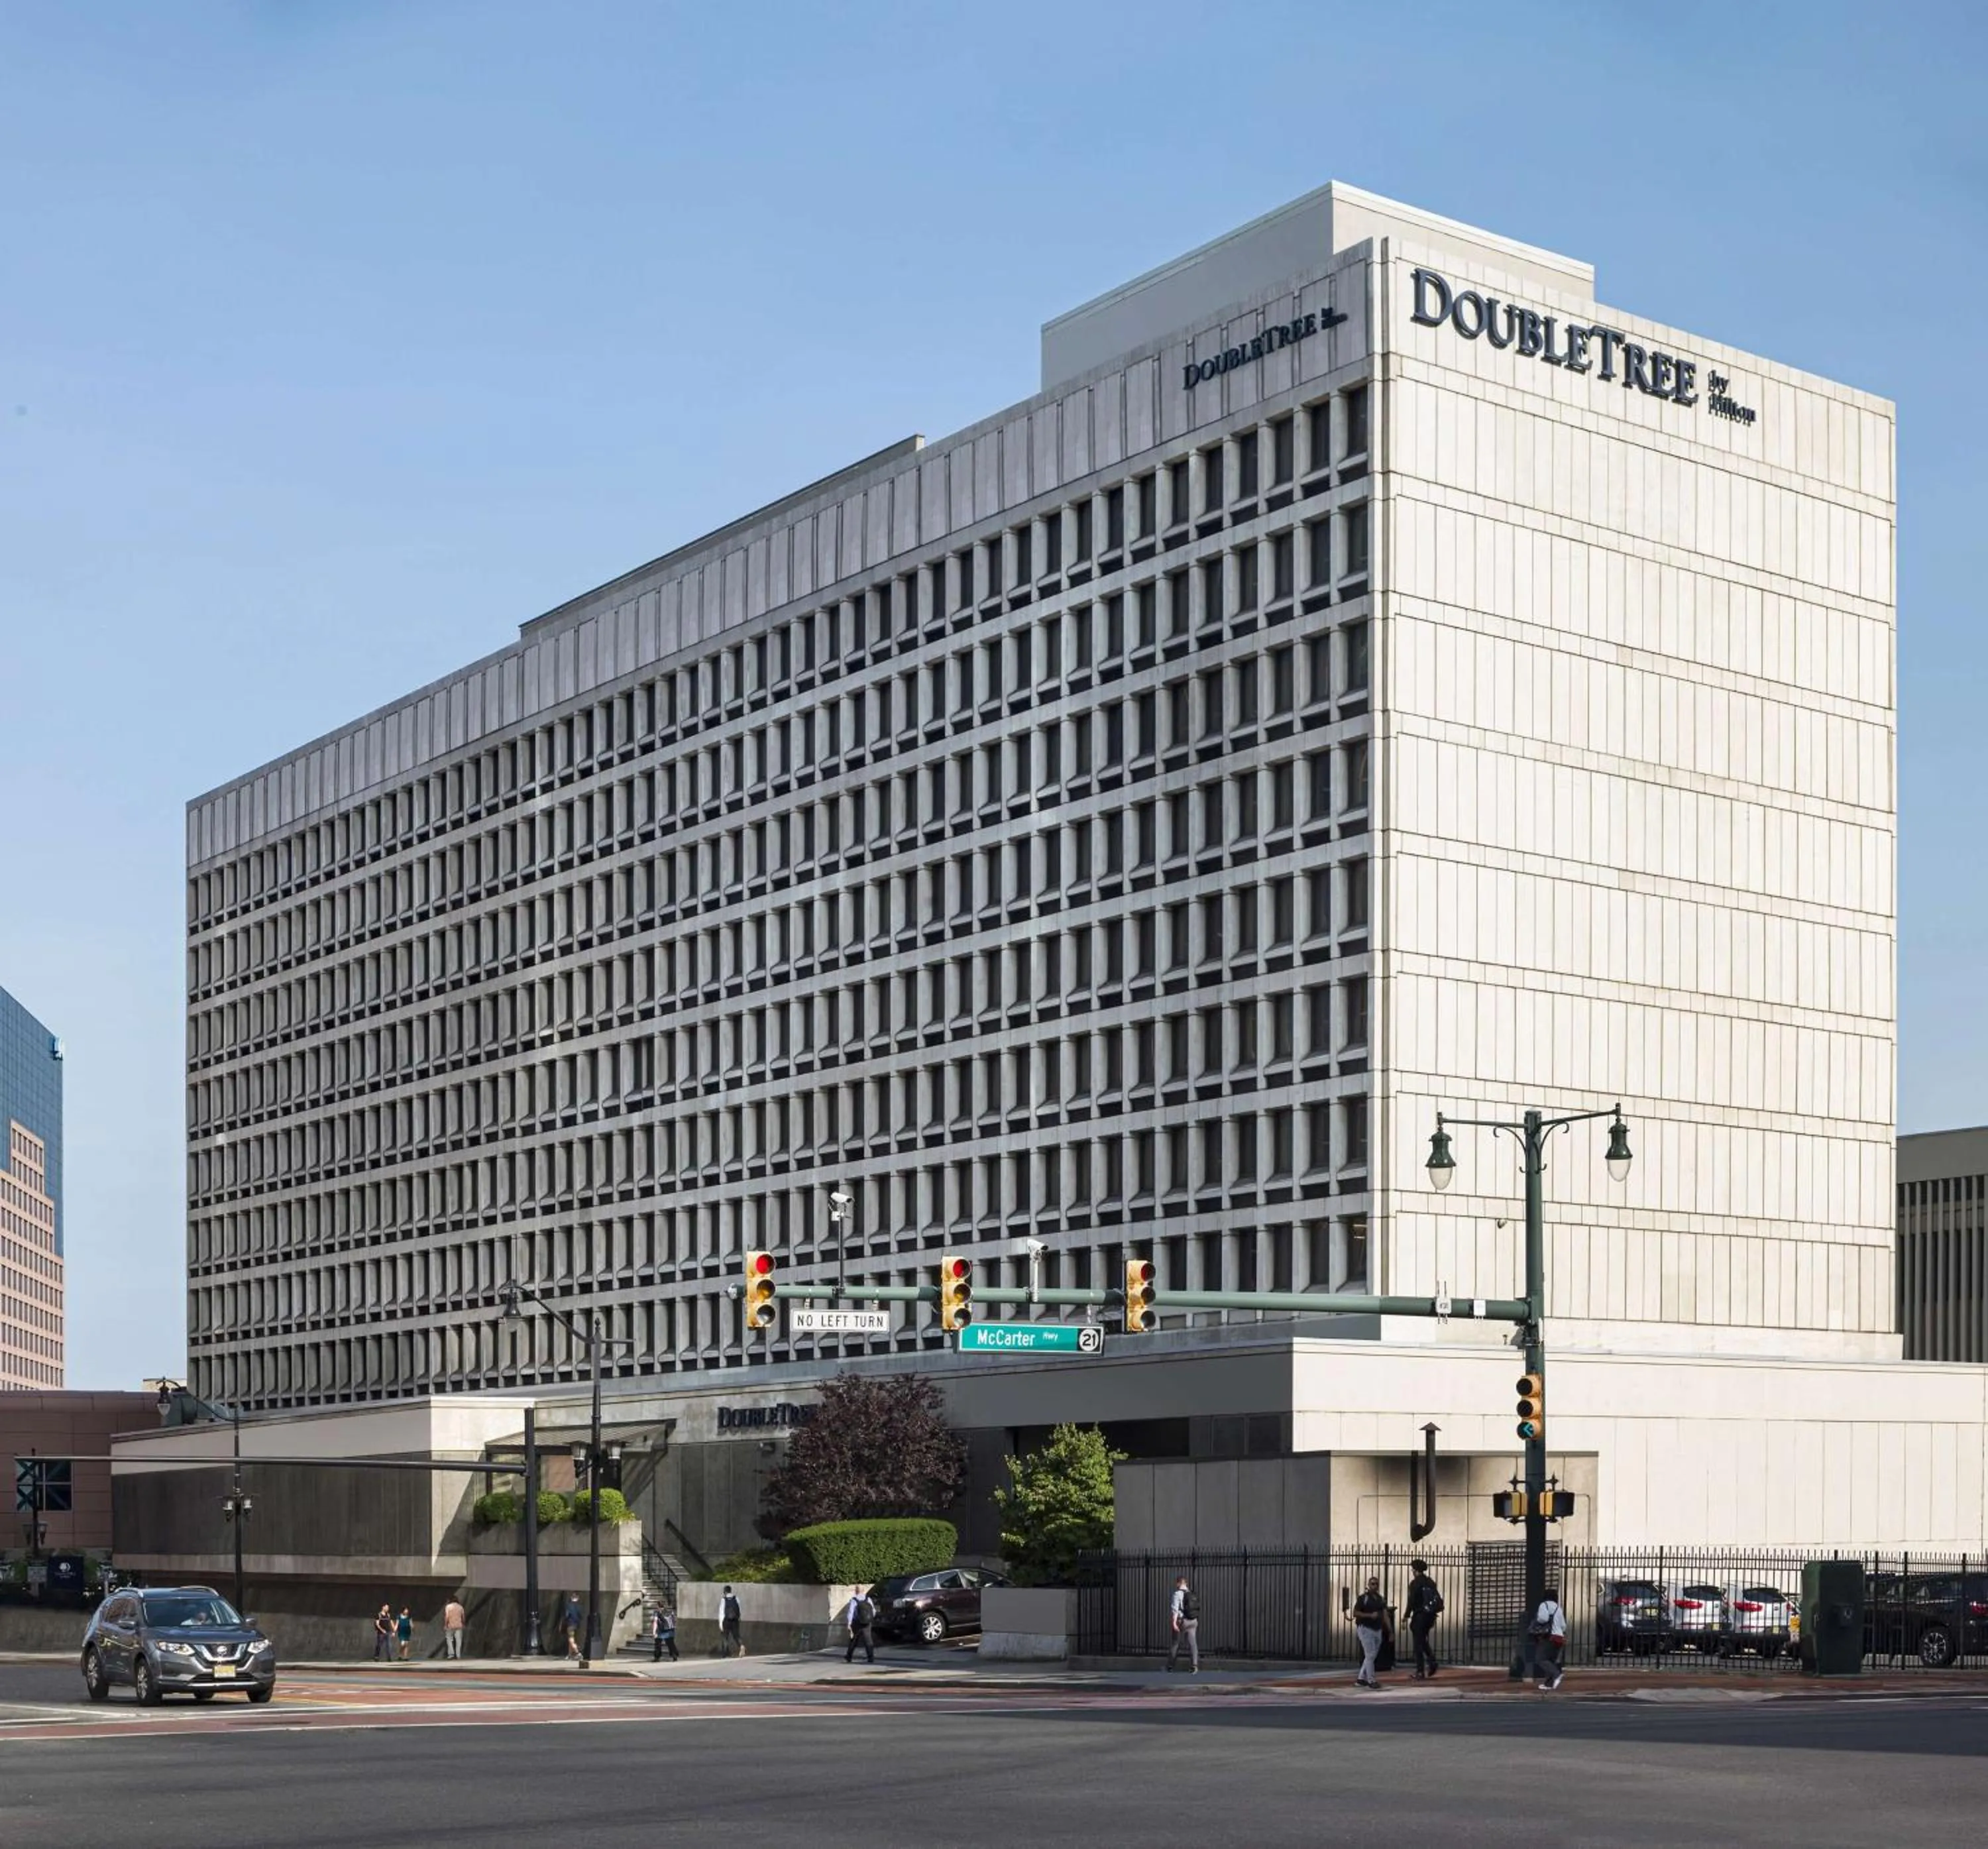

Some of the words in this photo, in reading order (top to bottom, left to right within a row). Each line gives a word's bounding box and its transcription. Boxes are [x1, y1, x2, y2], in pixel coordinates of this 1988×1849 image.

[1182, 313, 1317, 390] DOUBLETREE
[1410, 268, 1698, 406] DOUBLETREE
[797, 1314, 813, 1326] NO
[821, 1315, 848, 1327] LEFT
[854, 1316, 883, 1327] TURN
[977, 1329, 1035, 1346] McCarter
[1042, 1332, 1058, 1341] Hwy
[1083, 1334, 1096, 1347] 21
